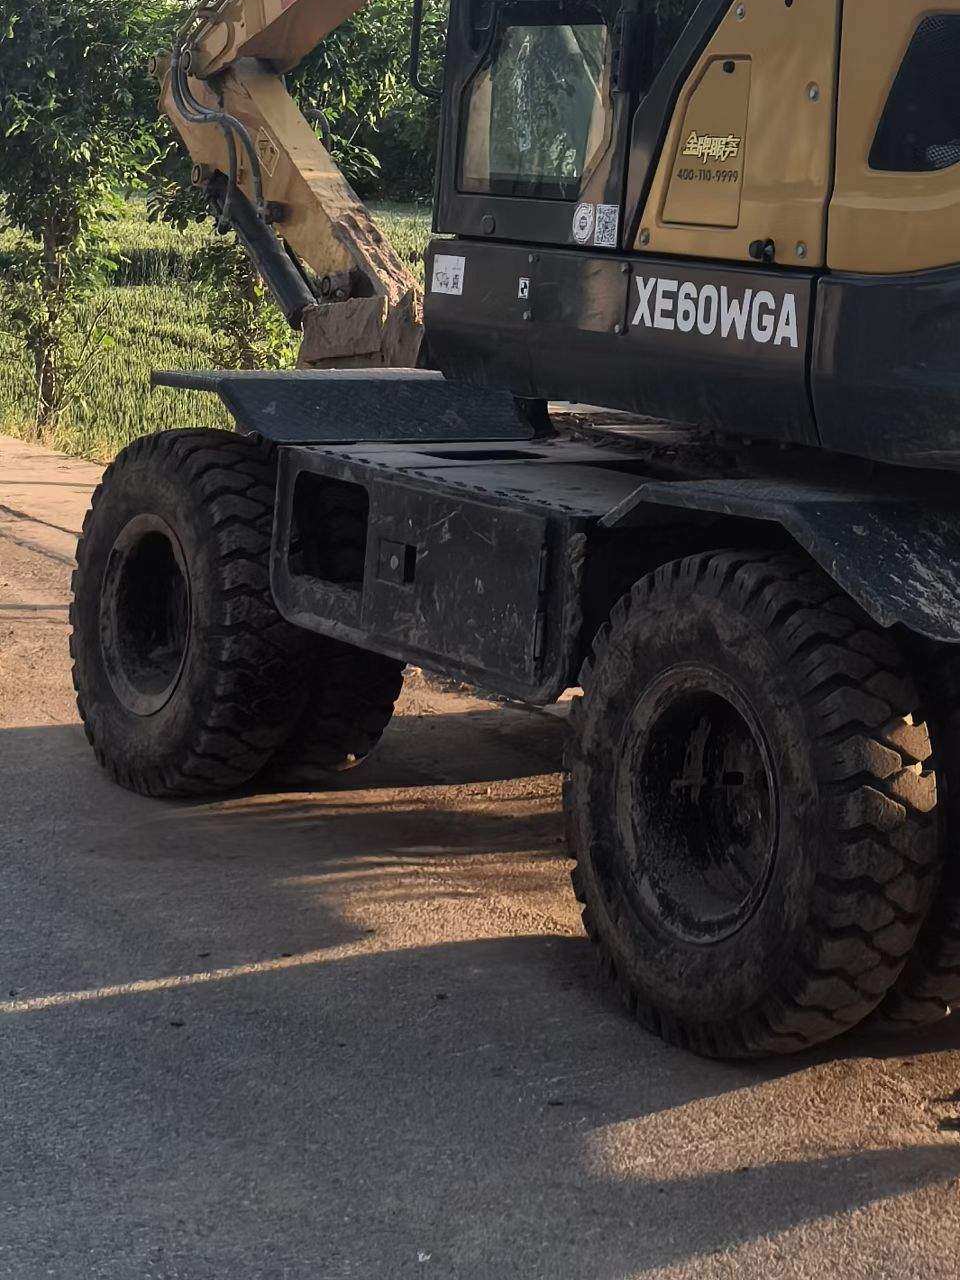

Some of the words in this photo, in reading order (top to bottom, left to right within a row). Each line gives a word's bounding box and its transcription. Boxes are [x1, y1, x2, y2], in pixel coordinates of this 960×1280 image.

[682, 130, 741, 164] 金牌服务
[677, 168, 739, 183] 400-110-9999
[631, 275, 799, 349] XE60WGA
